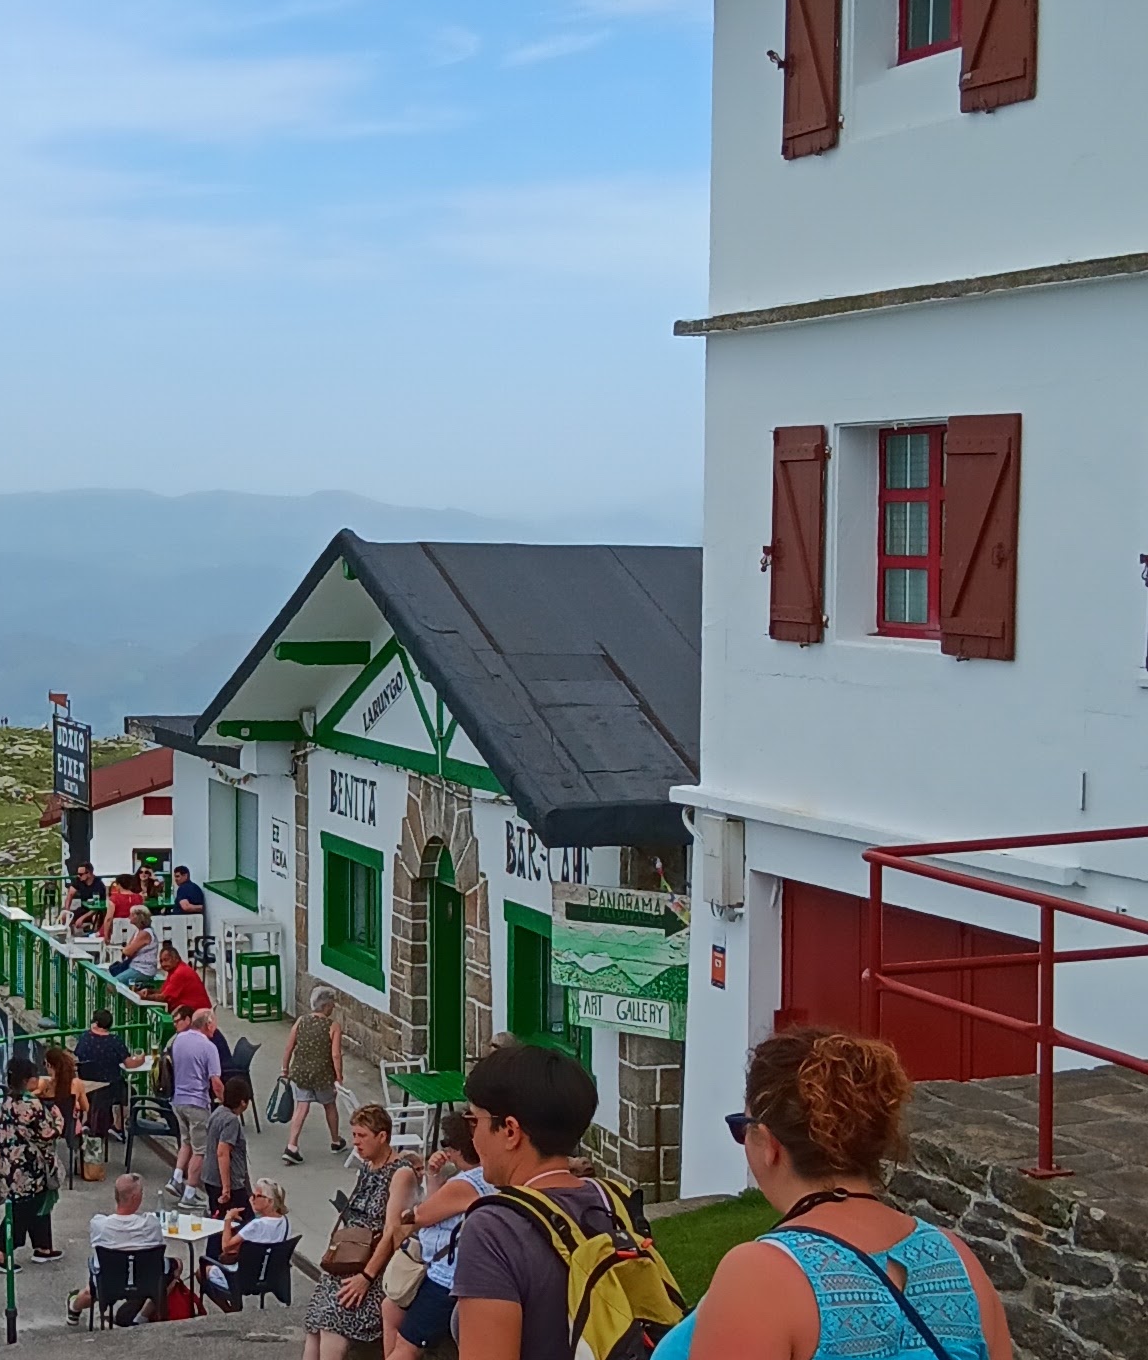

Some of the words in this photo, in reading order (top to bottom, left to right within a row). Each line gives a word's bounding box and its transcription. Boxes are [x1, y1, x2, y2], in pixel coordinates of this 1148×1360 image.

[588, 887, 662, 916] PANORAMA
[584, 994, 604, 1016] ART
[616, 999, 664, 1024] GALLERY
